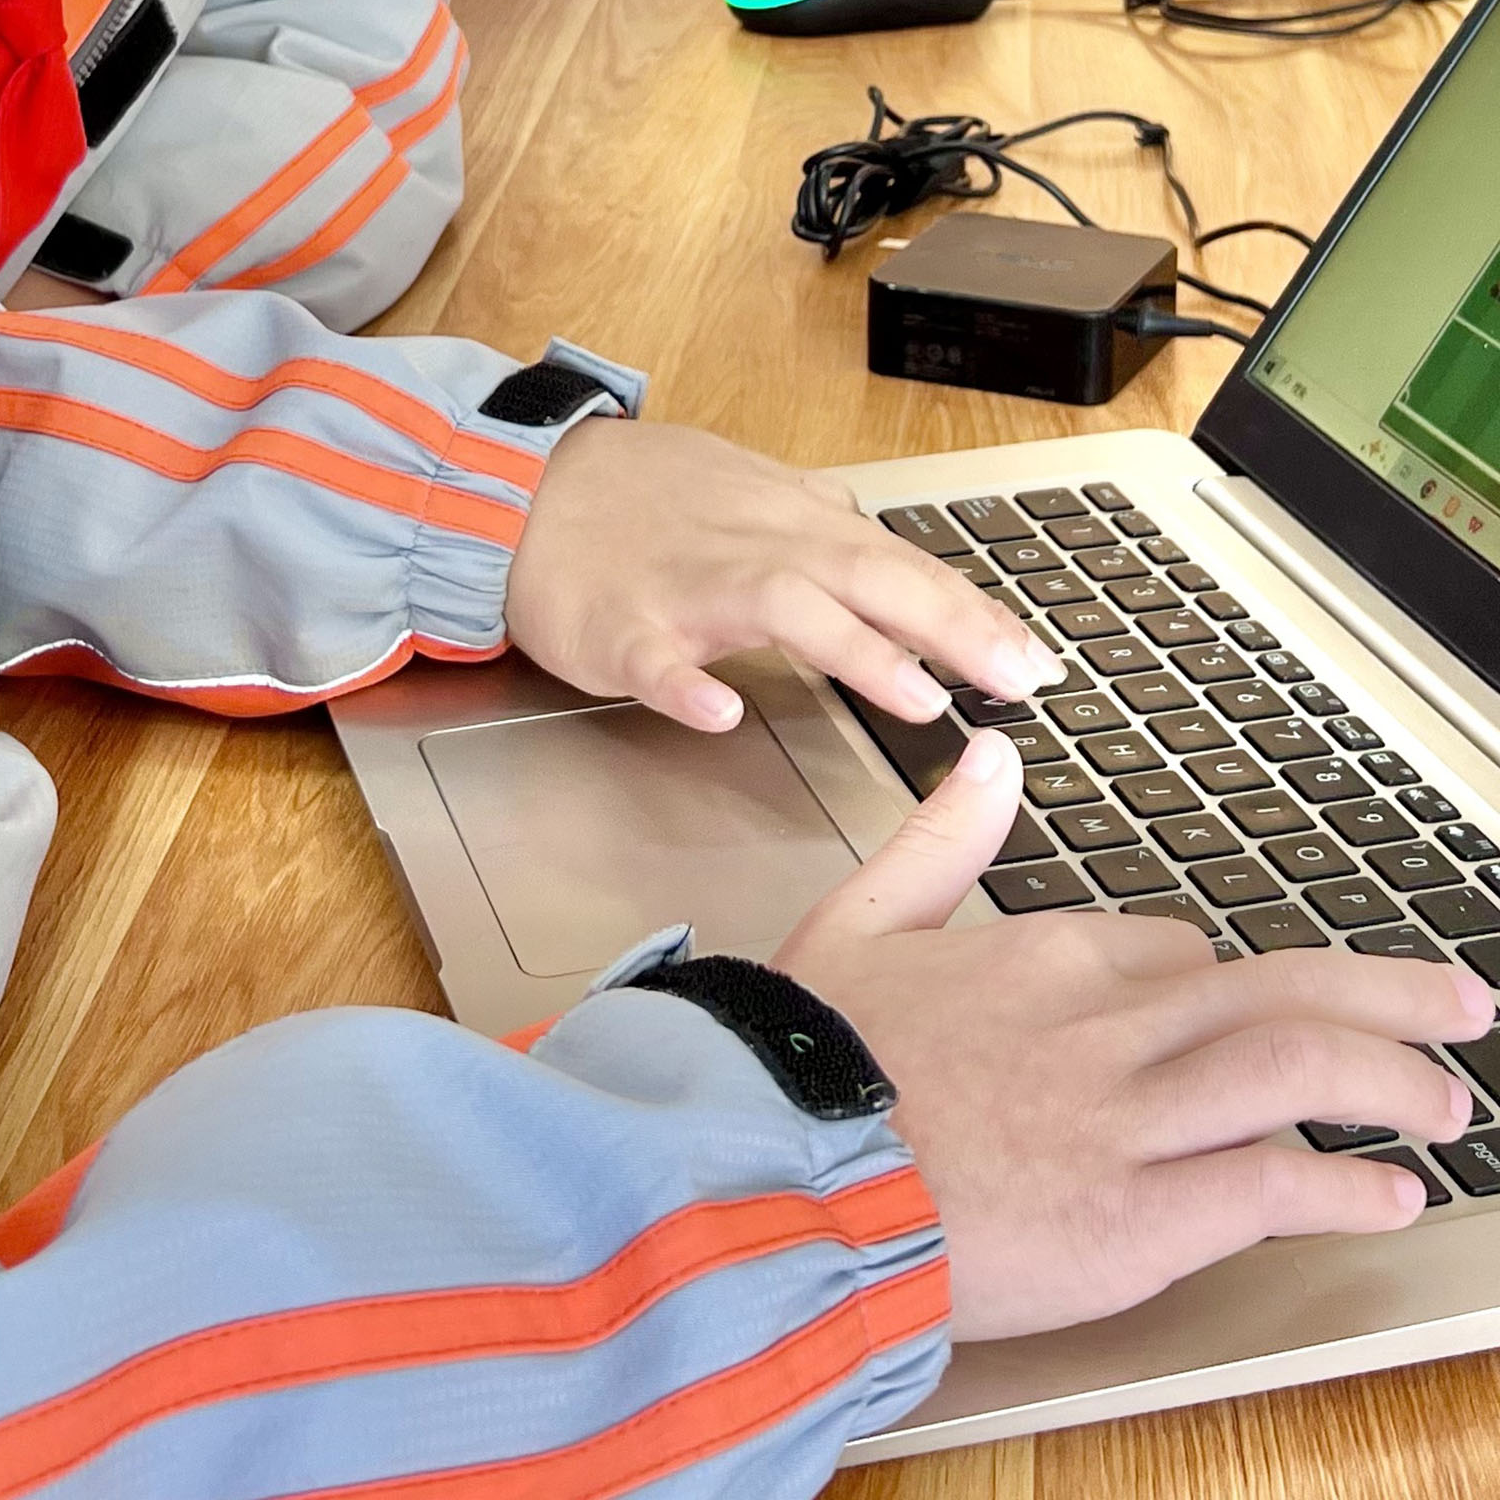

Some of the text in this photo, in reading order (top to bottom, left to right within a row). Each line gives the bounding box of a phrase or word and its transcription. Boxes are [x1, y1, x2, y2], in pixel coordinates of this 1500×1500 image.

[1016, 548, 1041, 561] Q
[1100, 556, 1124, 567] 2
[1045, 578, 1071, 592] W
[1132, 586, 1156, 597] 3
[1076, 613, 1101, 623] E
[1168, 621, 1191, 630] 4
[1108, 648, 1133, 659] R
[1201, 655, 1226, 666] 5
[1143, 683, 1169, 694] T
[1237, 692, 1263, 703] 6
[1073, 703, 1100, 717] G
[1178, 722, 1206, 734] Y
[1013, 736, 1038, 747] B
[1274, 730, 1303, 741] 7
[1107, 743, 1137, 758] H
[1215, 762, 1244, 775] U
[1044, 774, 1075, 789] N
[1315, 771, 1342, 783] 8
[1145, 787, 1172, 797] J
[1356, 812, 1384, 824] 9
[1078, 817, 1111, 834] M
[1181, 827, 1212, 841] K
[1296, 846, 1325, 861] O
[1401, 856, 1429, 868] 0
[1222, 873, 1248, 885] L
[1339, 893, 1368, 905] P
